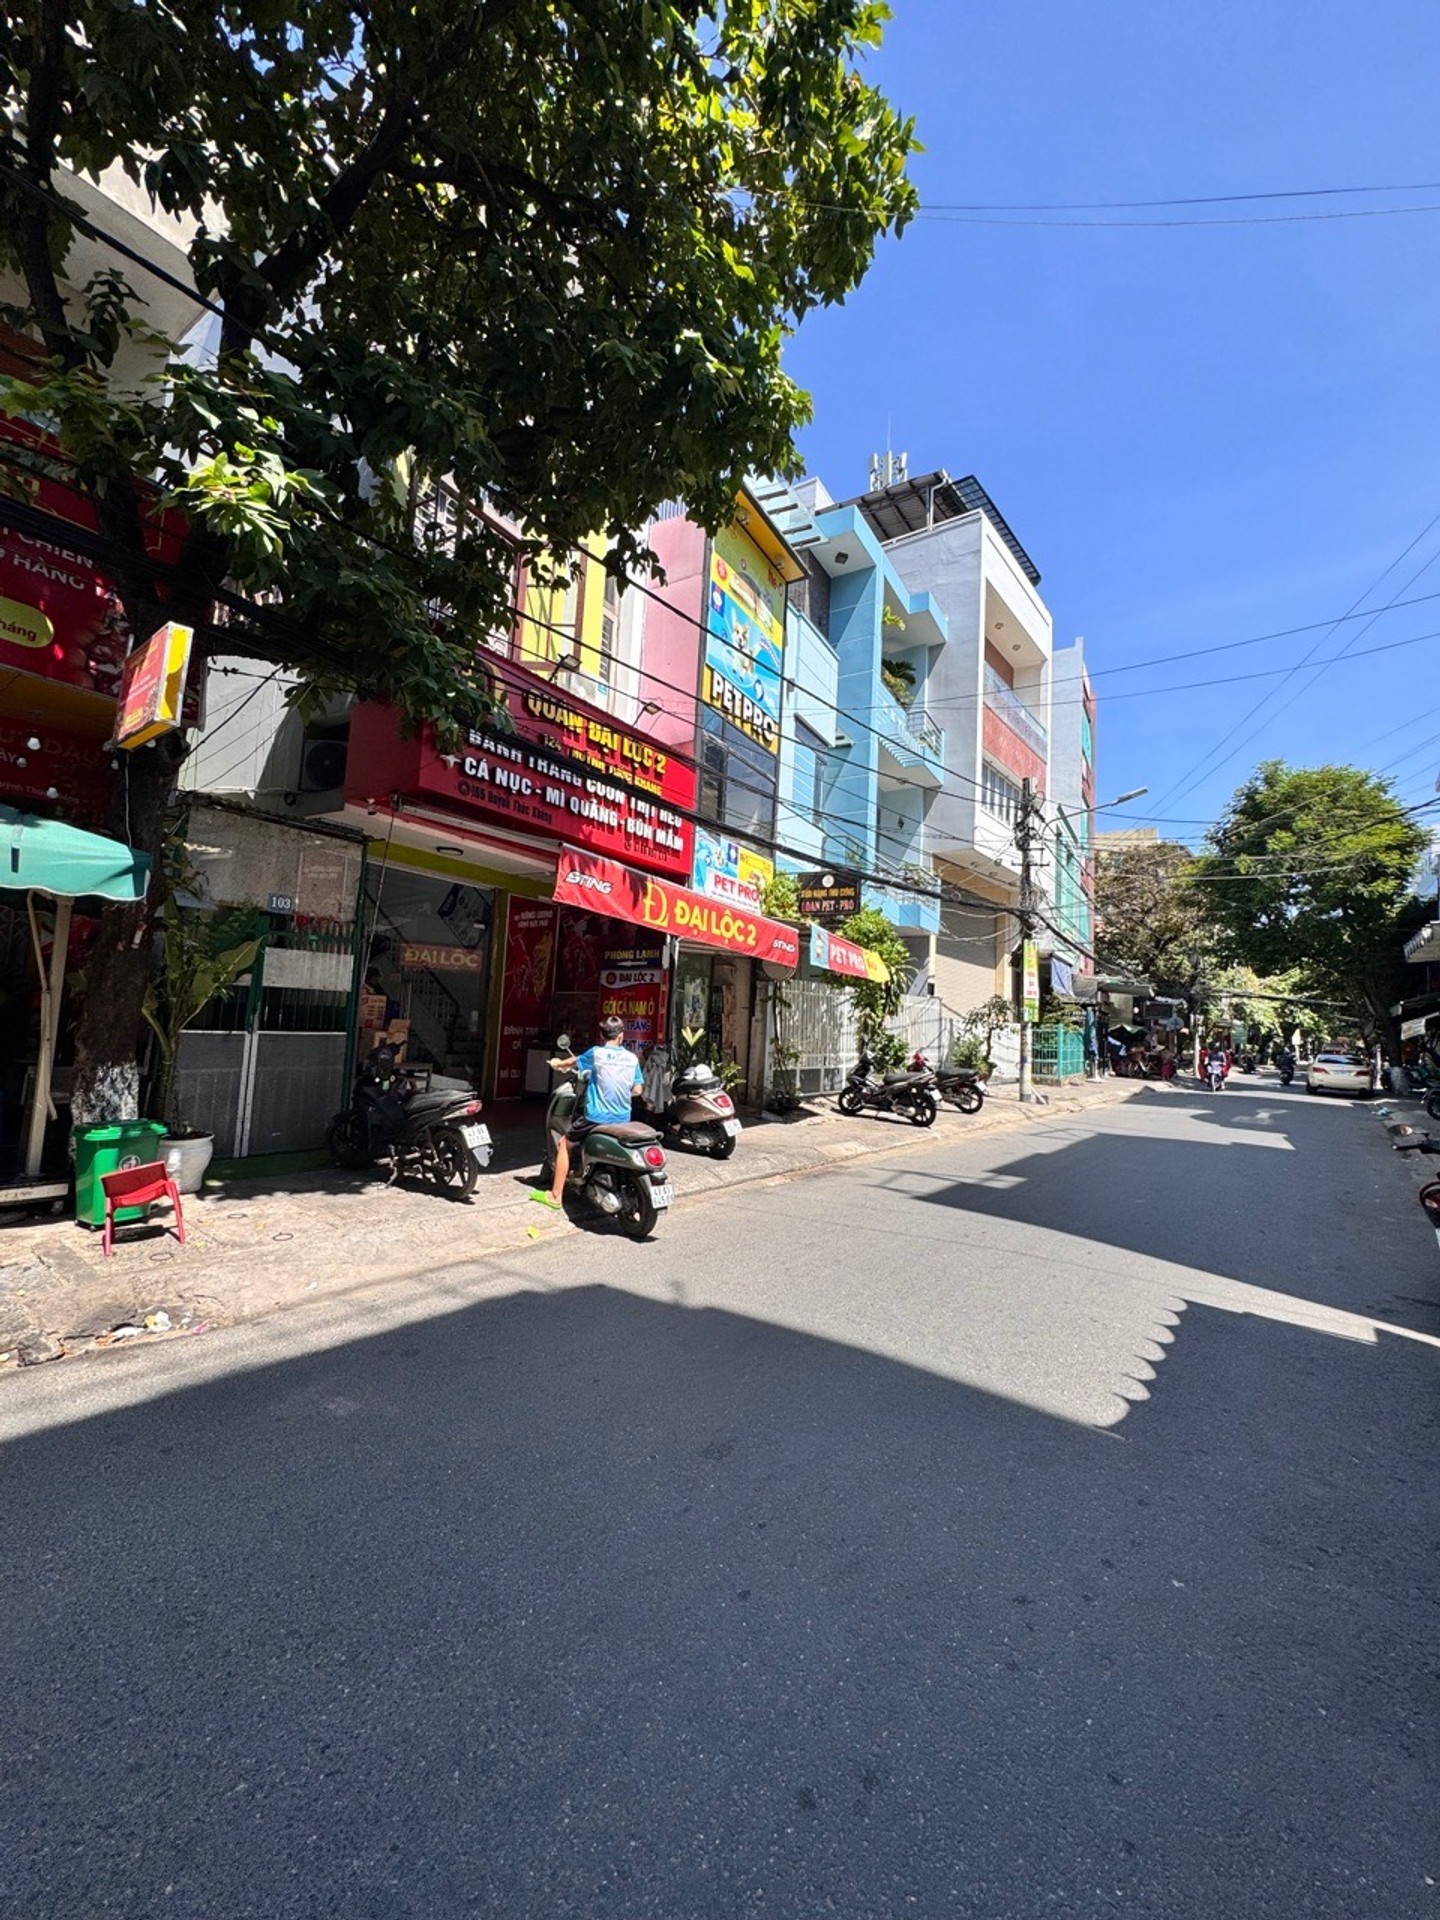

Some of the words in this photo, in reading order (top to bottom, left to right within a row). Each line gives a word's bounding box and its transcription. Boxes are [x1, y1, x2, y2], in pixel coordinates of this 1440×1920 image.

[13, 553, 85, 590] HÀNG
[655, 753, 666, 774] 2
[464, 756, 490, 780] CÁ
[495, 767, 533, 795] NỤC
[545, 786, 566, 808] MÌ
[569, 796, 619, 827] QUẢNG
[713, 873, 736, 895] PET
[737, 883, 760, 903] PRO
[271, 896, 291, 909] 103
[564, 871, 613, 895] STING
[674, 898, 708, 936] ĐẠI
[711, 908, 745, 945] LỘC
[746, 923, 757, 947] 2
[830, 944, 848, 966] PET
[649, 973, 656, 982] 2
